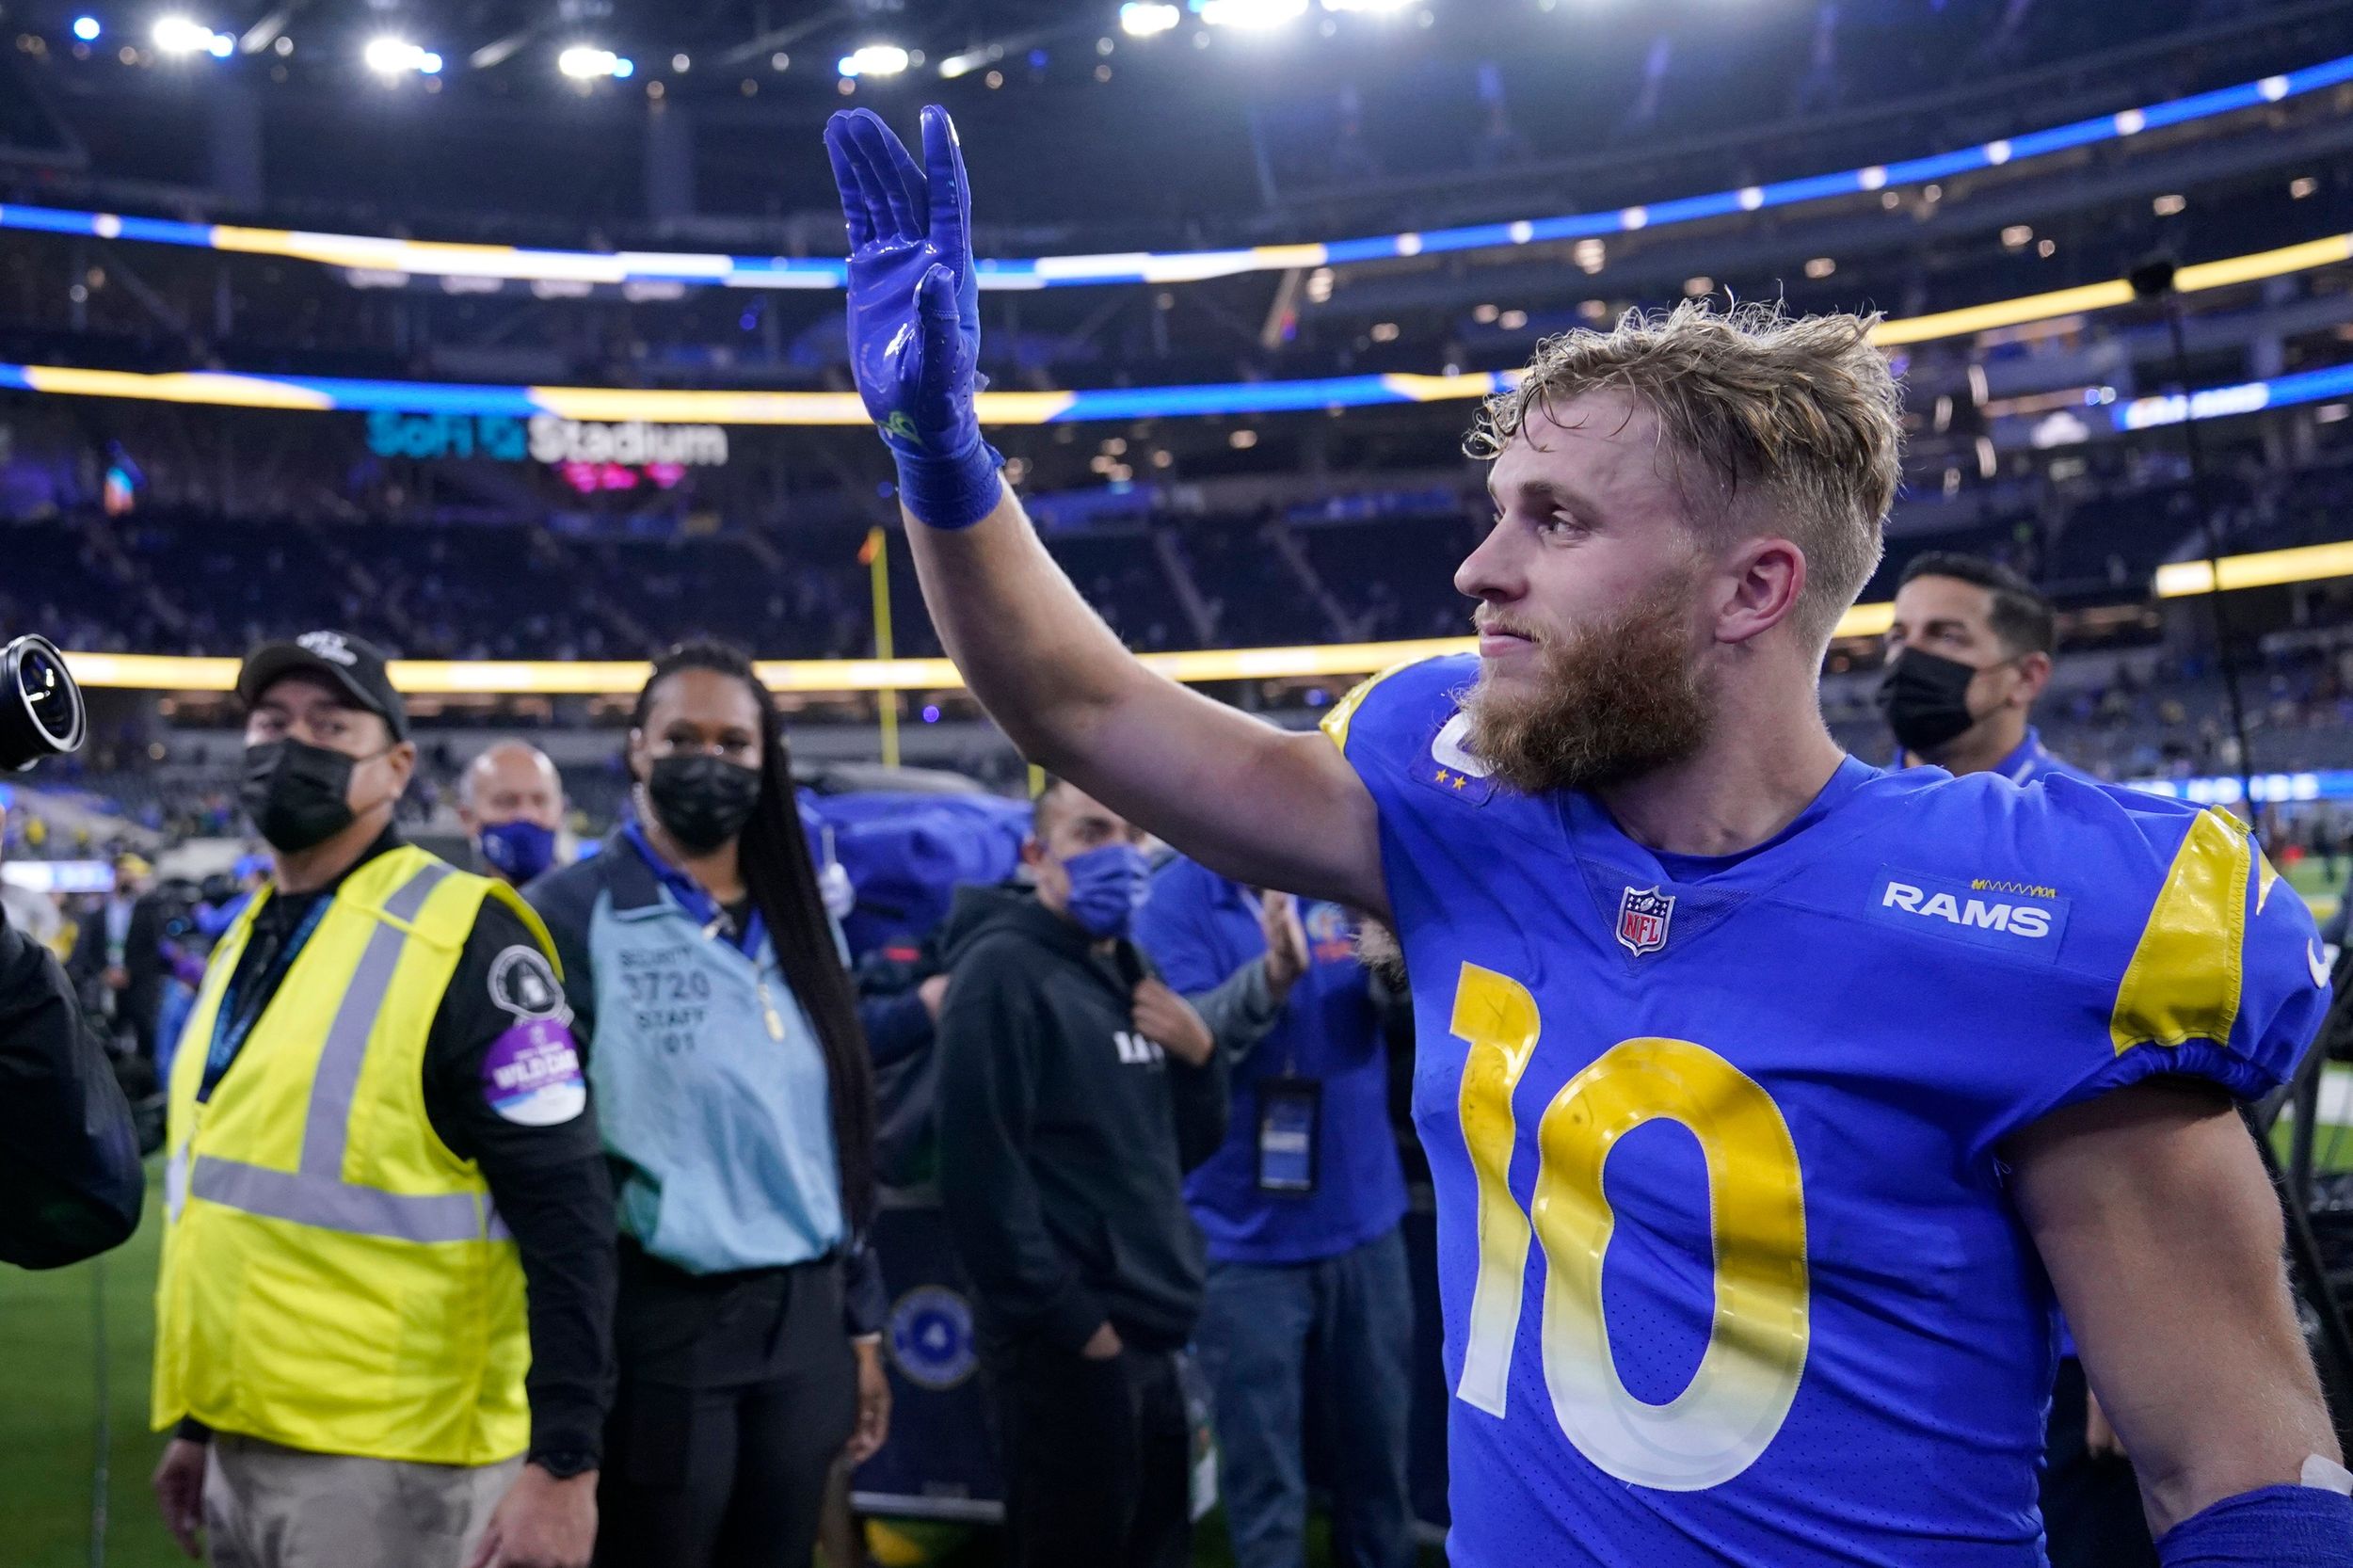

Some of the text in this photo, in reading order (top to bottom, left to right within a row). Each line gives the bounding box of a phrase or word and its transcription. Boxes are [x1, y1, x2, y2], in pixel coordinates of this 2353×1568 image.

[528, 412, 728, 467] Stadium
[1624, 911, 1659, 944] NFL
[1882, 881, 2052, 938] RAMS
[622, 968, 712, 1001] 3720
[635, 1006, 707, 1032] STAFF
[1449, 960, 1810, 1492] 10
